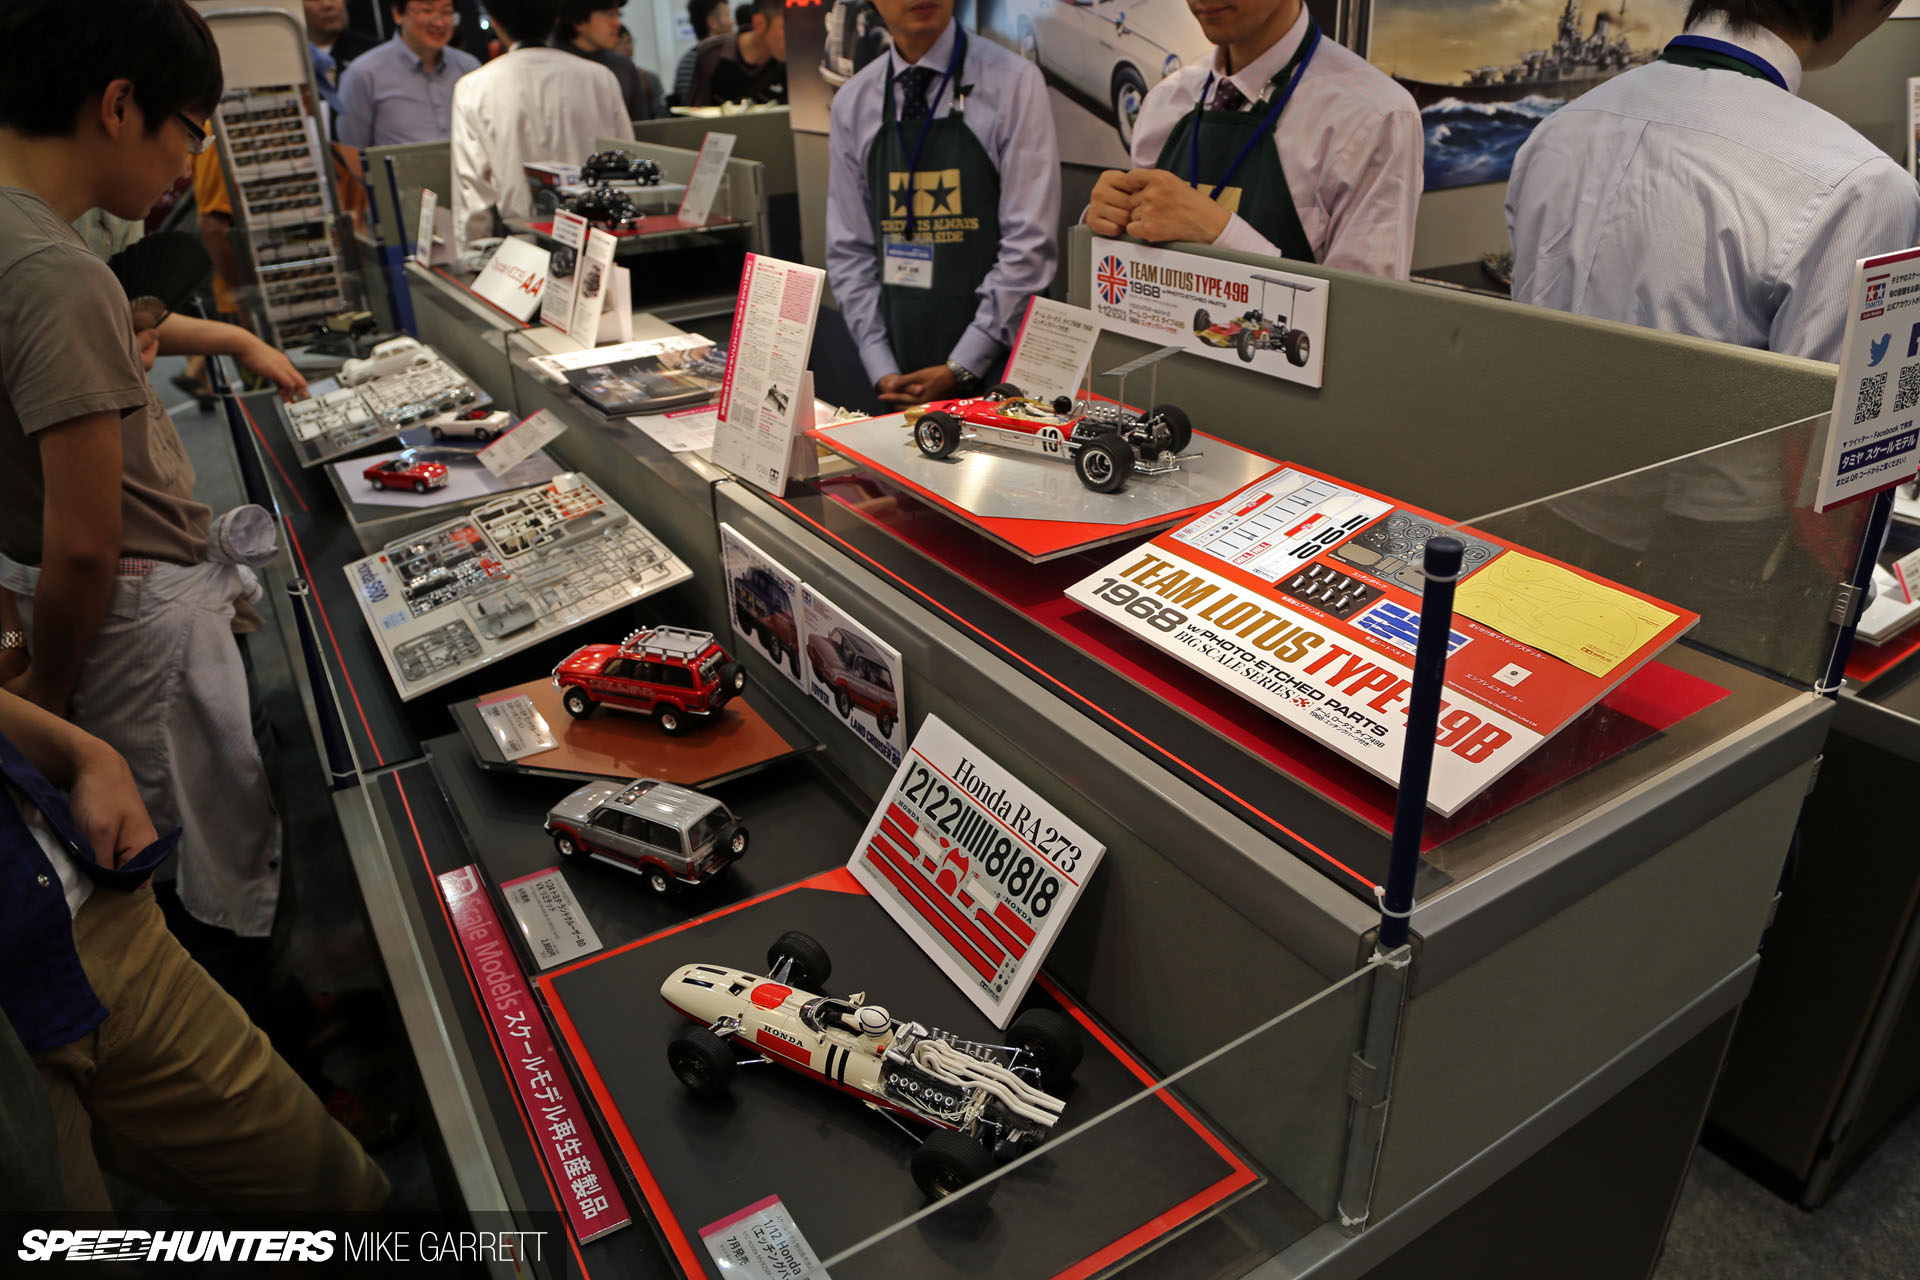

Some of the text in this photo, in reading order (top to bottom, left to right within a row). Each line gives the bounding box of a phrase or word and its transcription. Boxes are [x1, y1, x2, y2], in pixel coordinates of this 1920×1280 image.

[1129, 281, 1160, 298] 1968
[1130, 261, 1157, 283] TEAM
[1160, 267, 1194, 291] LOTUS
[1195, 274, 1222, 298] TYPE
[1224, 281, 1249, 303] 49B
[1042, 429, 1058, 453] 10
[1841, 434, 1916, 470] タミヤ スケールモデル
[1873, 425, 1899, 439] Facebook
[1119, 553, 1221, 610] TEAM
[1197, 593, 1325, 664] LOTUS
[1302, 644, 1412, 714] TYPE
[1092, 578, 1389, 737] 1968 w/PHOTO-ETCHED PARTS
[1174, 630, 1203, 648] BIG
[1197, 643, 1246, 672] SCALE
[1240, 665, 1294, 701] SERIES
[1465, 673, 1525, 703] エンブレムステッカー
[850, 716, 866, 738] LAND
[866, 730, 892, 761] CRUISER
[1314, 706, 1385, 748] チーム ロータス タイプ49B
[898, 800, 920, 822] HONDA
[952, 757, 1082, 873] Honda RA273
[1004, 896, 1032, 924] HONDA
[475, 940, 518, 1011] Models
[764, 1025, 803, 1047] HONDA
[504, 1010, 609, 1221] スケールモデル再生産製品
[727, 1236, 750, 1266] 7月発売
[751, 1224, 791, 1280] (エッチングパ
[763, 1219, 802, 1275] 1/12 Honda
